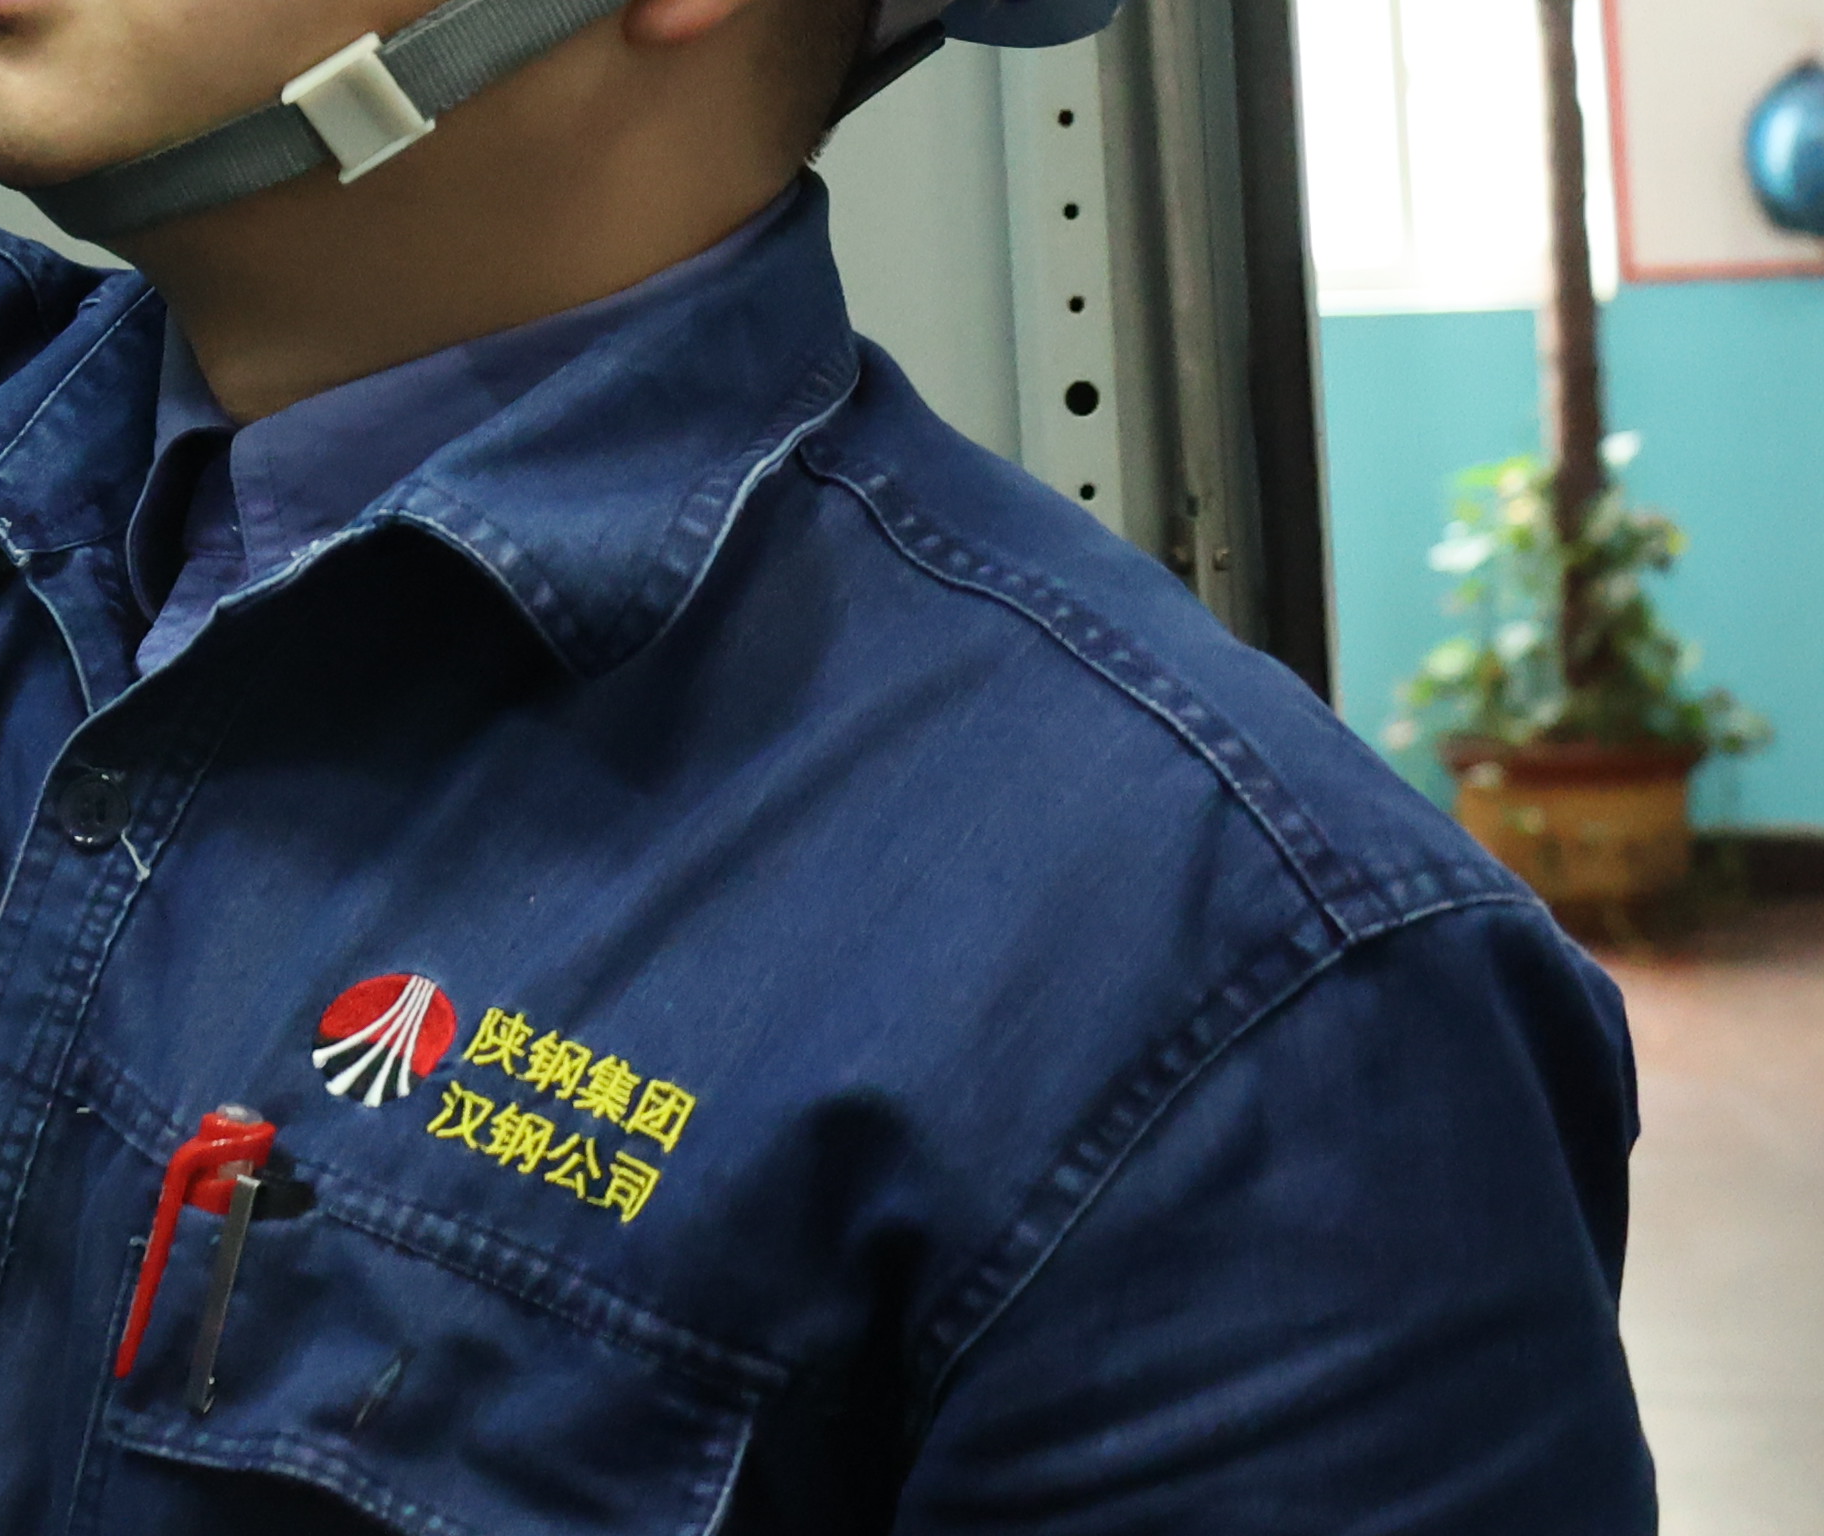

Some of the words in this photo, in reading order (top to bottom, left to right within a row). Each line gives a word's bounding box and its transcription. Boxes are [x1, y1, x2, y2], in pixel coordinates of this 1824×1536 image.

[426, 1080, 661, 1224] 汉钢公司
[463, 1007, 697, 1153] 陕钢集团
